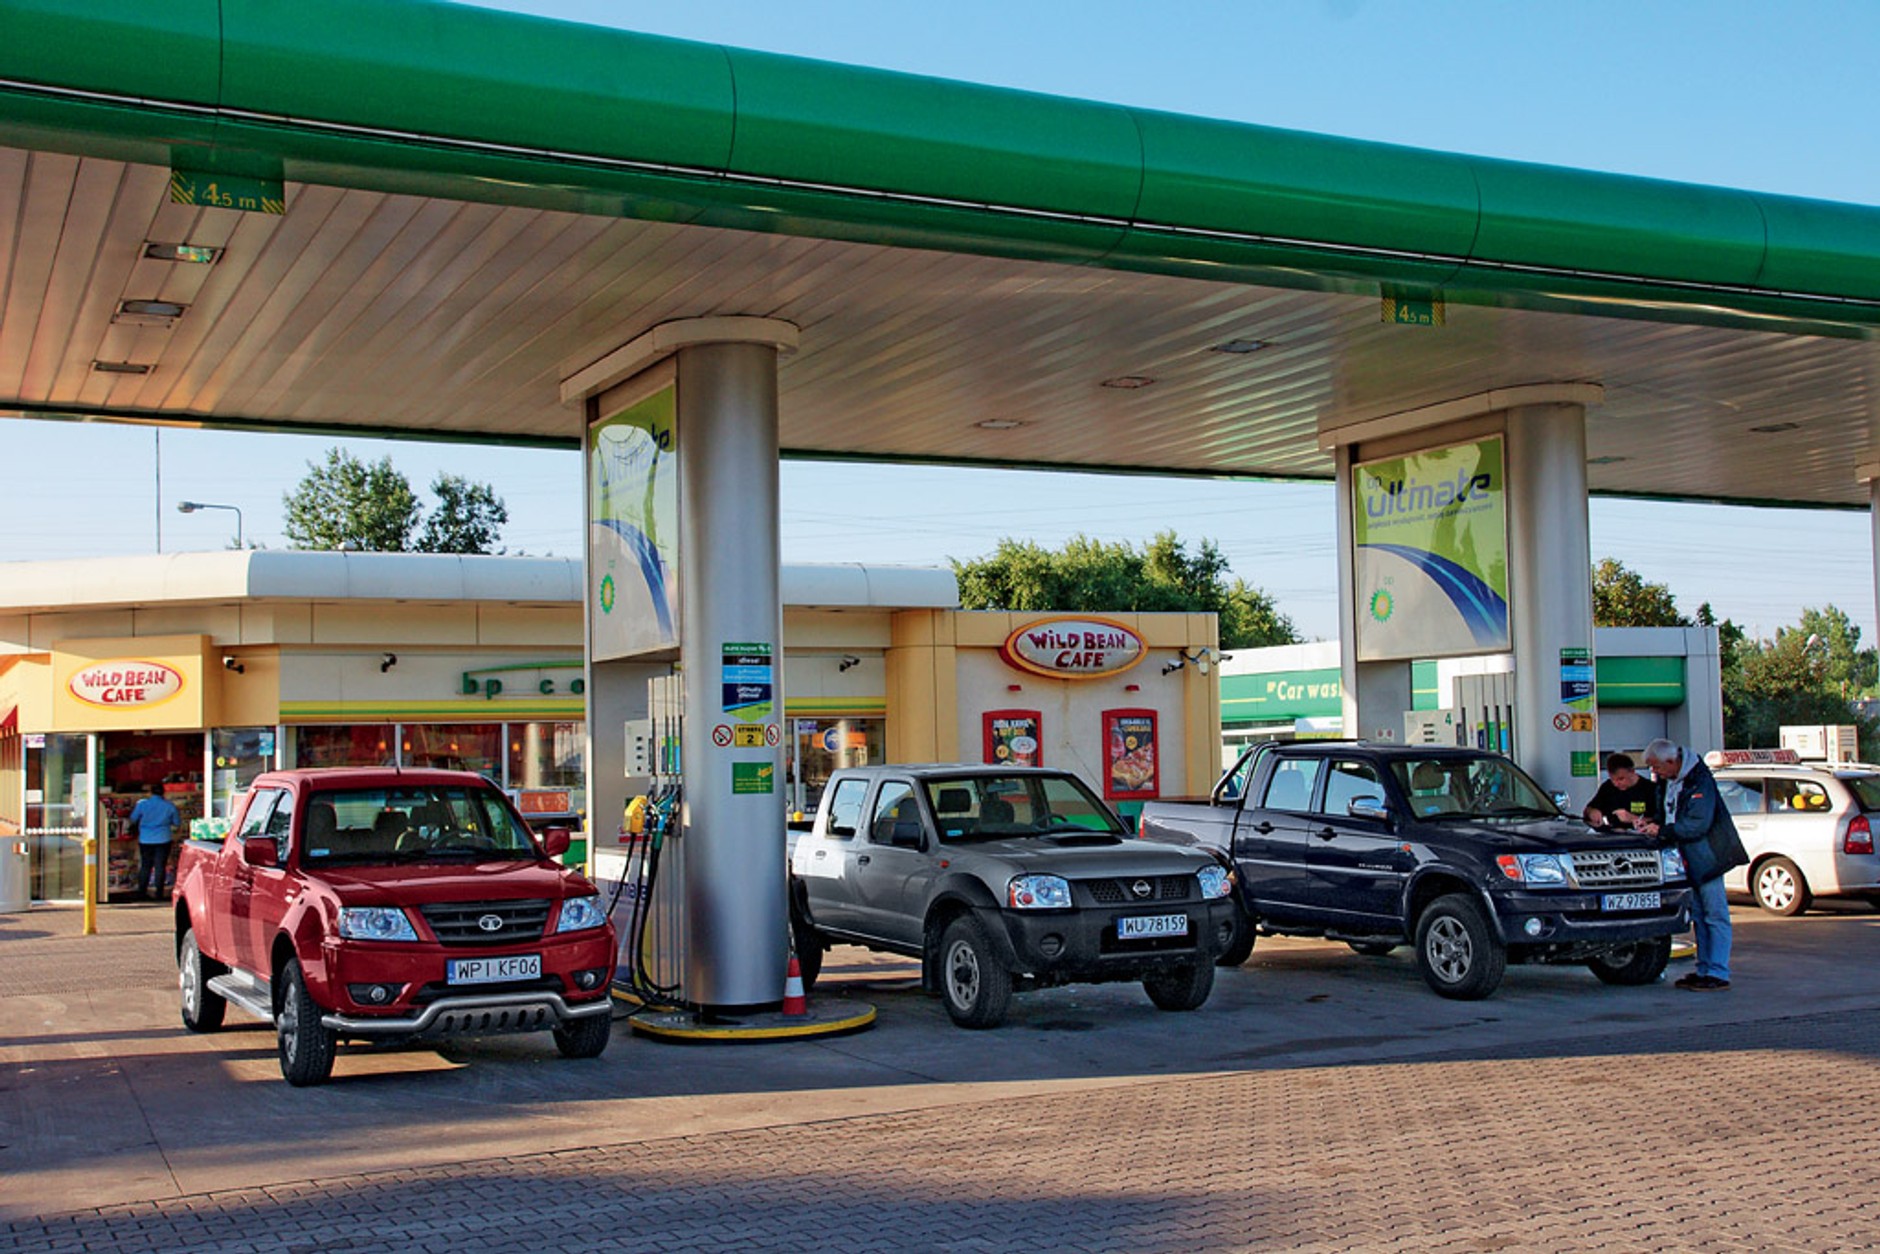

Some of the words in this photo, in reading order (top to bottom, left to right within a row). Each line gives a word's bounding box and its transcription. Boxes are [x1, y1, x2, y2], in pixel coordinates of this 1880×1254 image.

[238, 197, 256, 208] m
[1367, 466, 1492, 519] ultimate
[1083, 631, 1126, 650] BEAN
[1055, 650, 1105, 668] CAFE
[125, 670, 167, 686] BEAN
[463, 671, 503, 700] bp
[101, 688, 146, 702] CAFE
[1278, 681, 1304, 700] Car
[1444, 712, 1452, 726] 4
[746, 734, 755, 745] 2
[1125, 917, 1145, 934] WU
[1148, 915, 1186, 932] 78159
[499, 958, 538, 977] KF06
